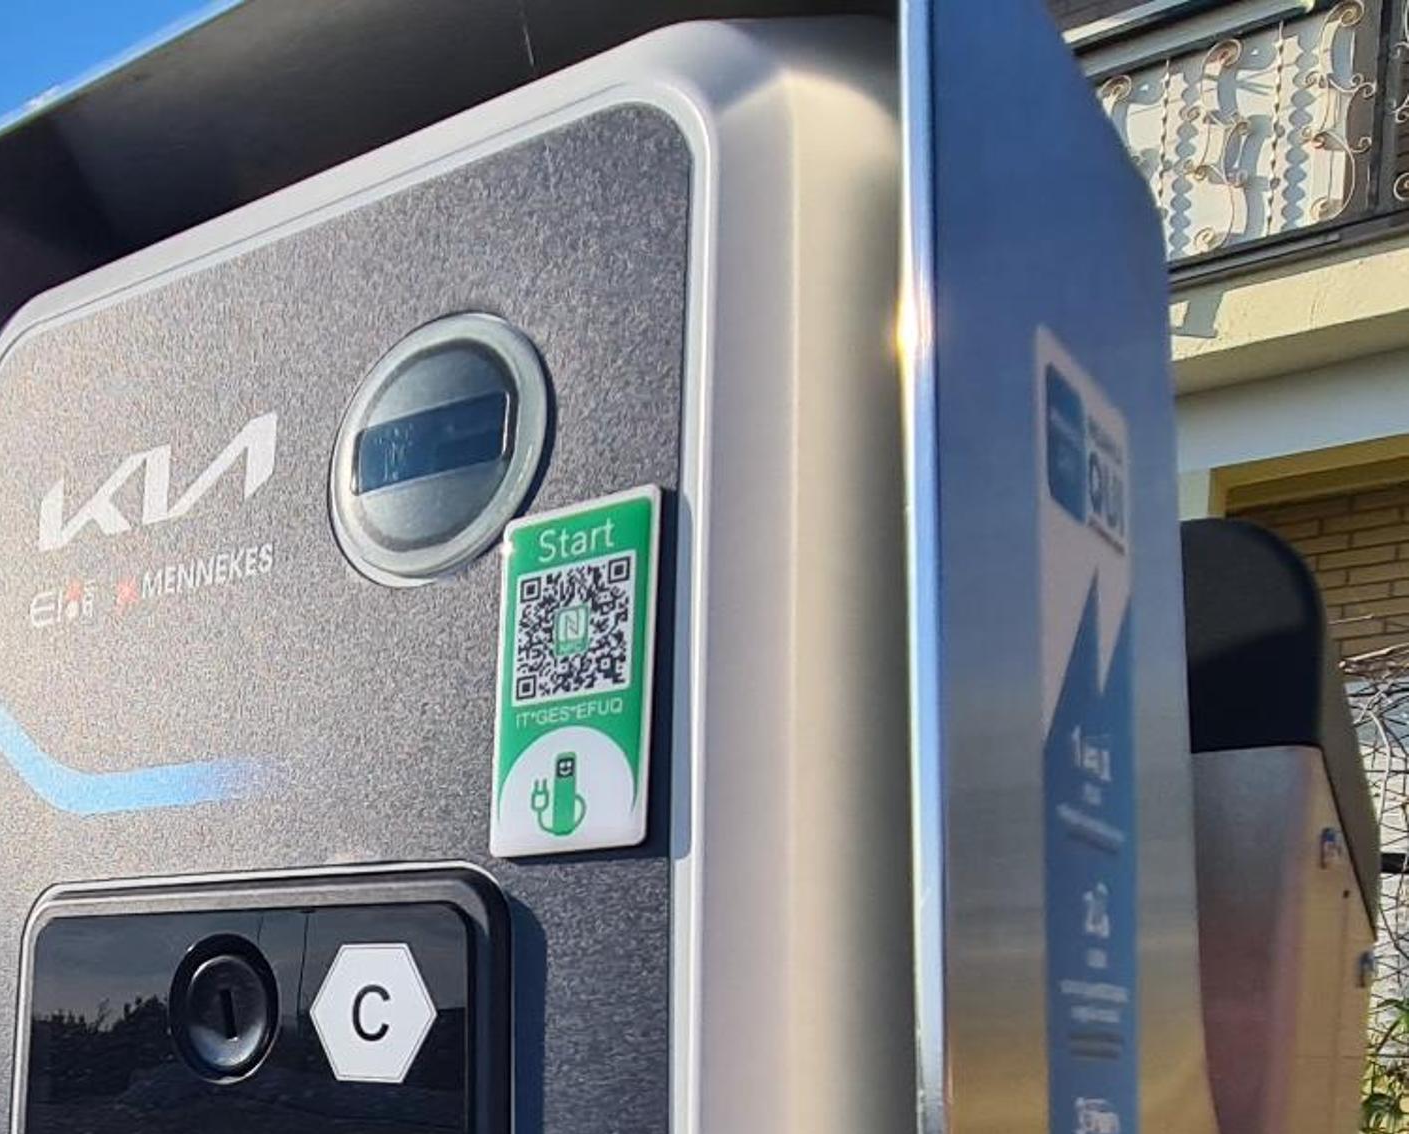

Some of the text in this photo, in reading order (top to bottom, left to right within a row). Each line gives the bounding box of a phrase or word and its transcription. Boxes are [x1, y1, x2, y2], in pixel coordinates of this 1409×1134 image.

[38, 410, 278, 552] KIA
[538, 517, 616, 563] Start
[142, 543, 274, 599] MENNEKES
[352, 984, 391, 1042] C
